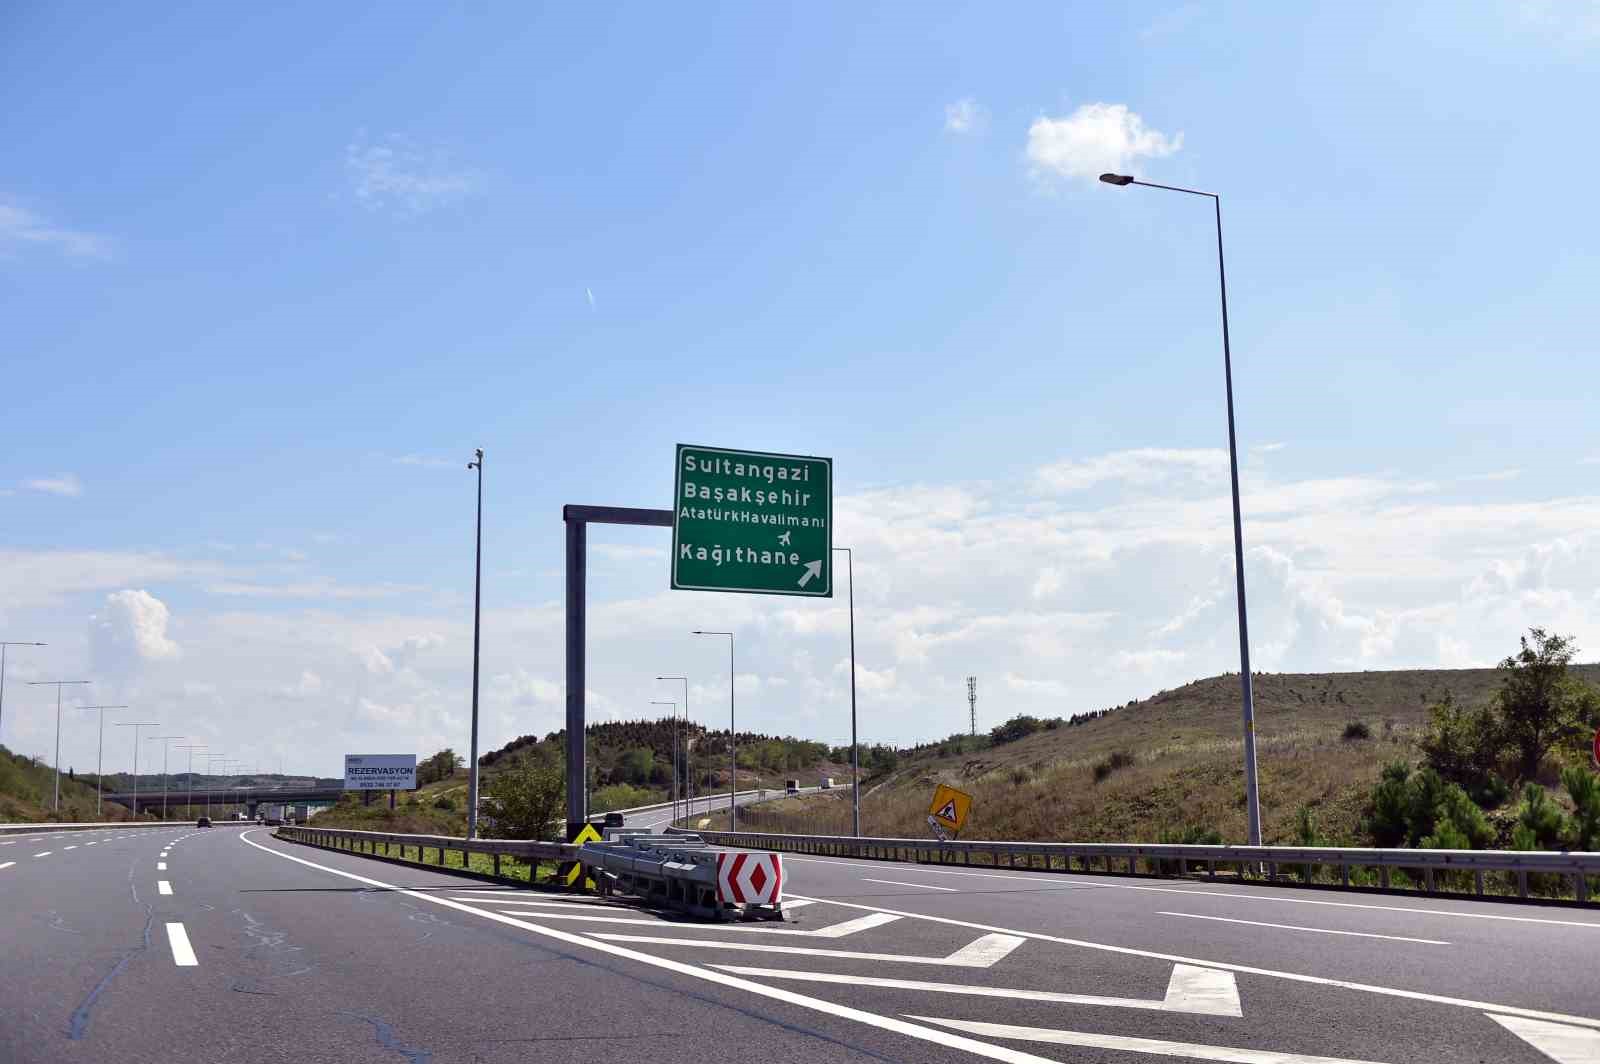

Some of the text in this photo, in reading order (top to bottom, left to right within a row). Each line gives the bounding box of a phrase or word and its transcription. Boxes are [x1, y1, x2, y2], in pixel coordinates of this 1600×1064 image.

[685, 455, 809, 483] Sultangazi
[684, 482, 811, 506] Başakşehir
[680, 543, 800, 566] Kağıthane
[348, 767, 414, 775] REZERVASYON
